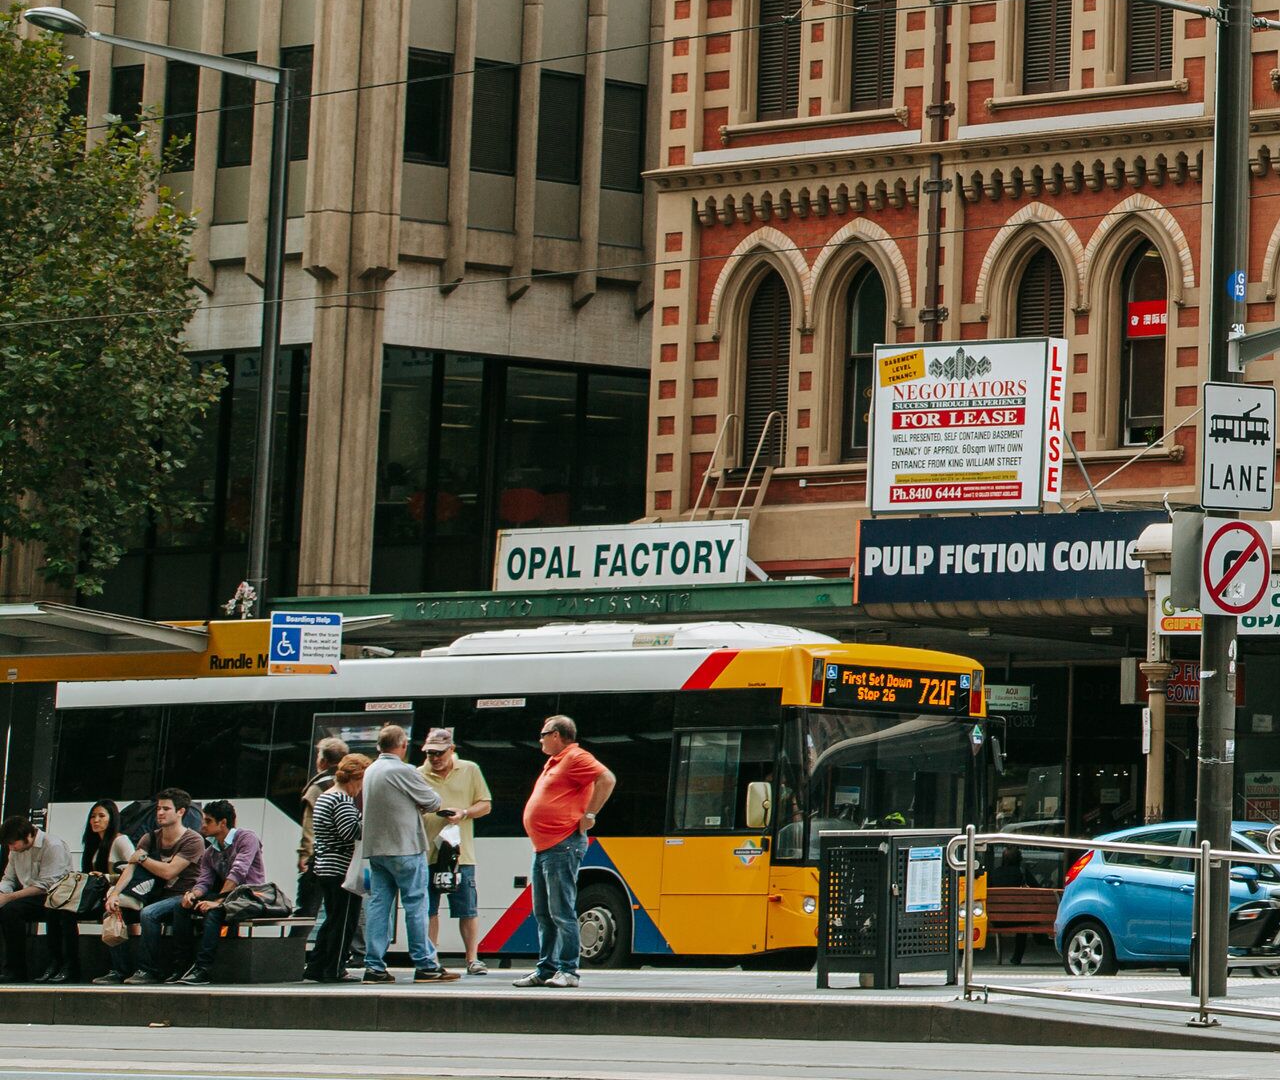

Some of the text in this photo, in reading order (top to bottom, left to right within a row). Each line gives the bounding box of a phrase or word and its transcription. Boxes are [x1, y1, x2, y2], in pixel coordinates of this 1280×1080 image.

[1237, 273, 1245, 284] G
[1235, 285, 1245, 296] 13
[884, 353, 918, 367] BASEMENT
[892, 364, 912, 374] LEVEL
[888, 371, 918, 383] TENANCY
[892, 380, 1027, 401] NEGOTIATORS
[894, 398, 1024, 410] SUCCESS THROUGH EXPERIENCE
[900, 410, 1017, 428] FOR LEASE
[1048, 346, 1062, 493] LEASE
[893, 433, 908, 443] WELL
[944, 432, 958, 441] SELF
[959, 431, 991, 441] CONTAINED
[992, 430, 1023, 440] BASEMENT
[892, 447, 922, 456] TENANCY
[923, 446, 931, 455] OF
[962, 444, 987, 456] 60sqm
[988, 444, 1005, 453] WITH
[1007, 443, 1023, 453] OWN
[891, 457, 1022, 469] ENTRANCE FROM KING WILLIAM STREET
[1209, 463, 1267, 493] LANE
[935, 486, 961, 499] 6444
[507, 539, 735, 581] OPAL FACTORY
[864, 539, 1146, 576] PULP FICTION COMIC
[210, 654, 252, 670] Rundle
[842, 670, 913, 689] First Set Down
[857, 687, 896, 702] Stop 26
[918, 677, 957, 706] 721F
